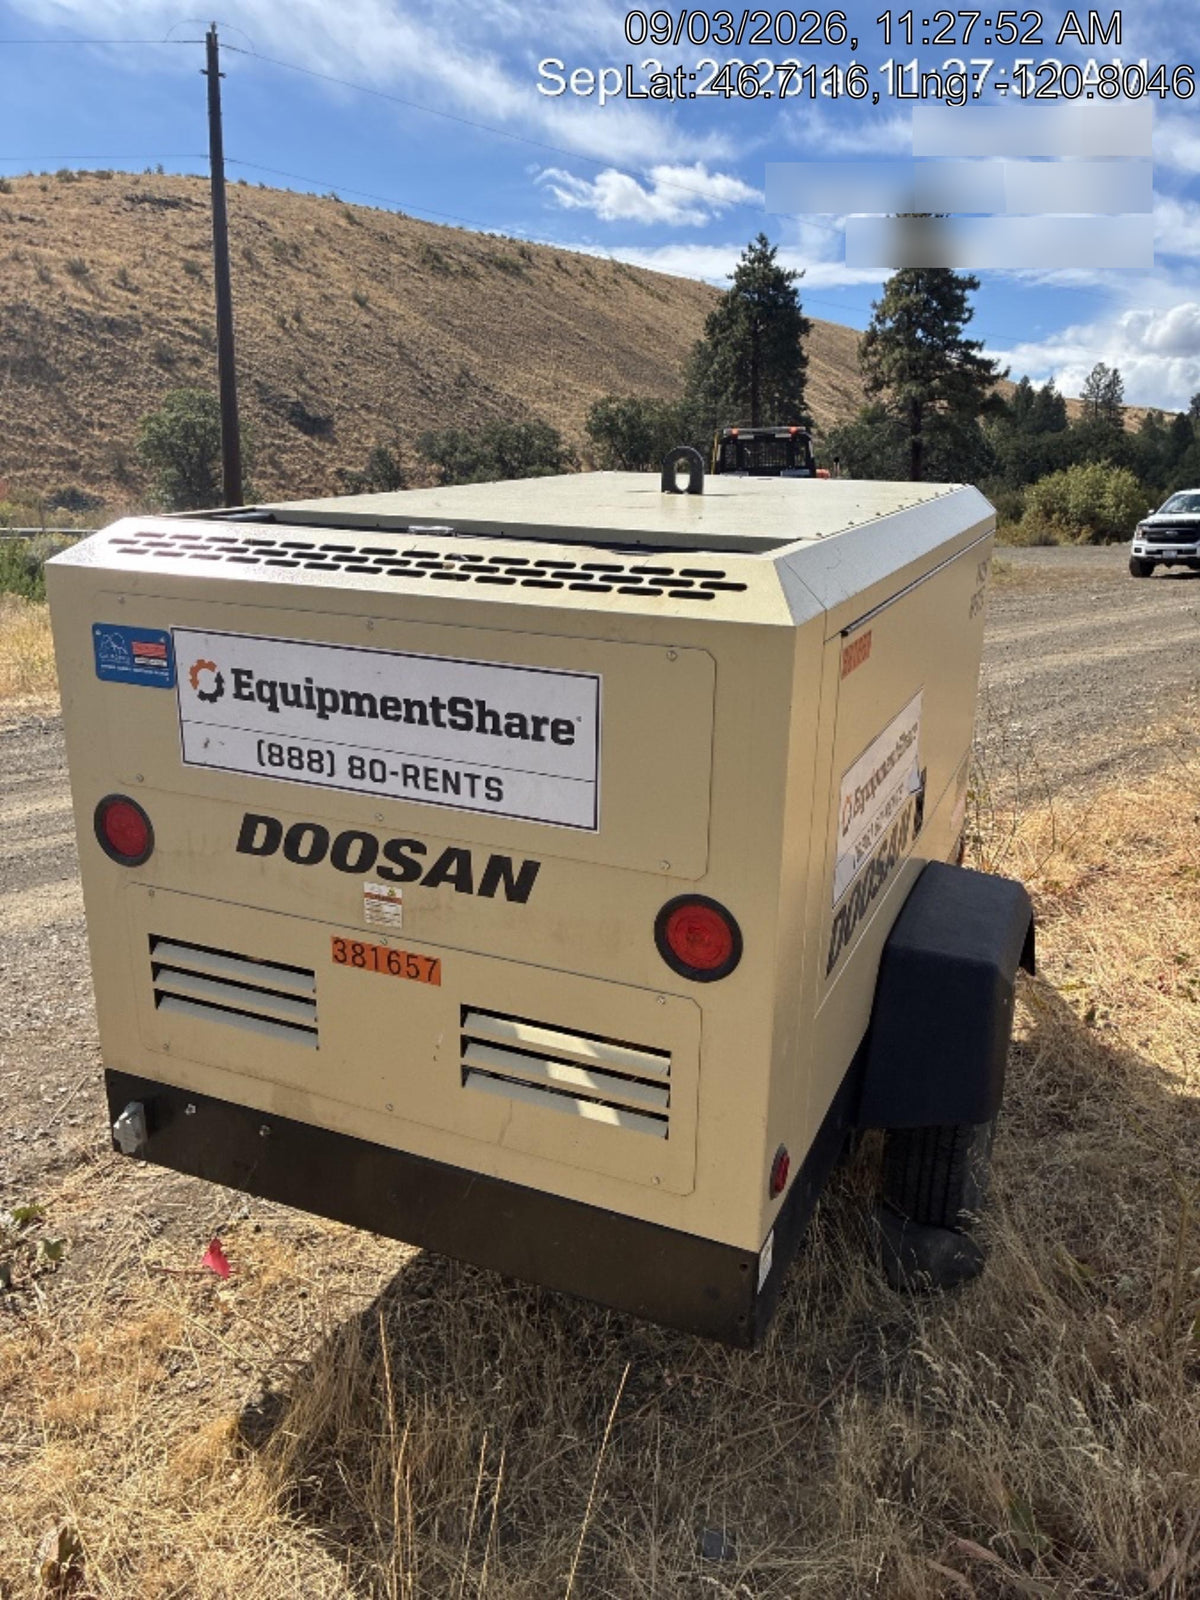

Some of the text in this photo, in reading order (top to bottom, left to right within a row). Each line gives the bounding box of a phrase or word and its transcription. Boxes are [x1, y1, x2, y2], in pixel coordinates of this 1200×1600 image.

[230, 667, 576, 746] EquipmentShare
[257, 739, 504, 803] (888) 80-RENTS
[236, 812, 542, 904] DOOSAN
[332, 936, 441, 984] 381657
